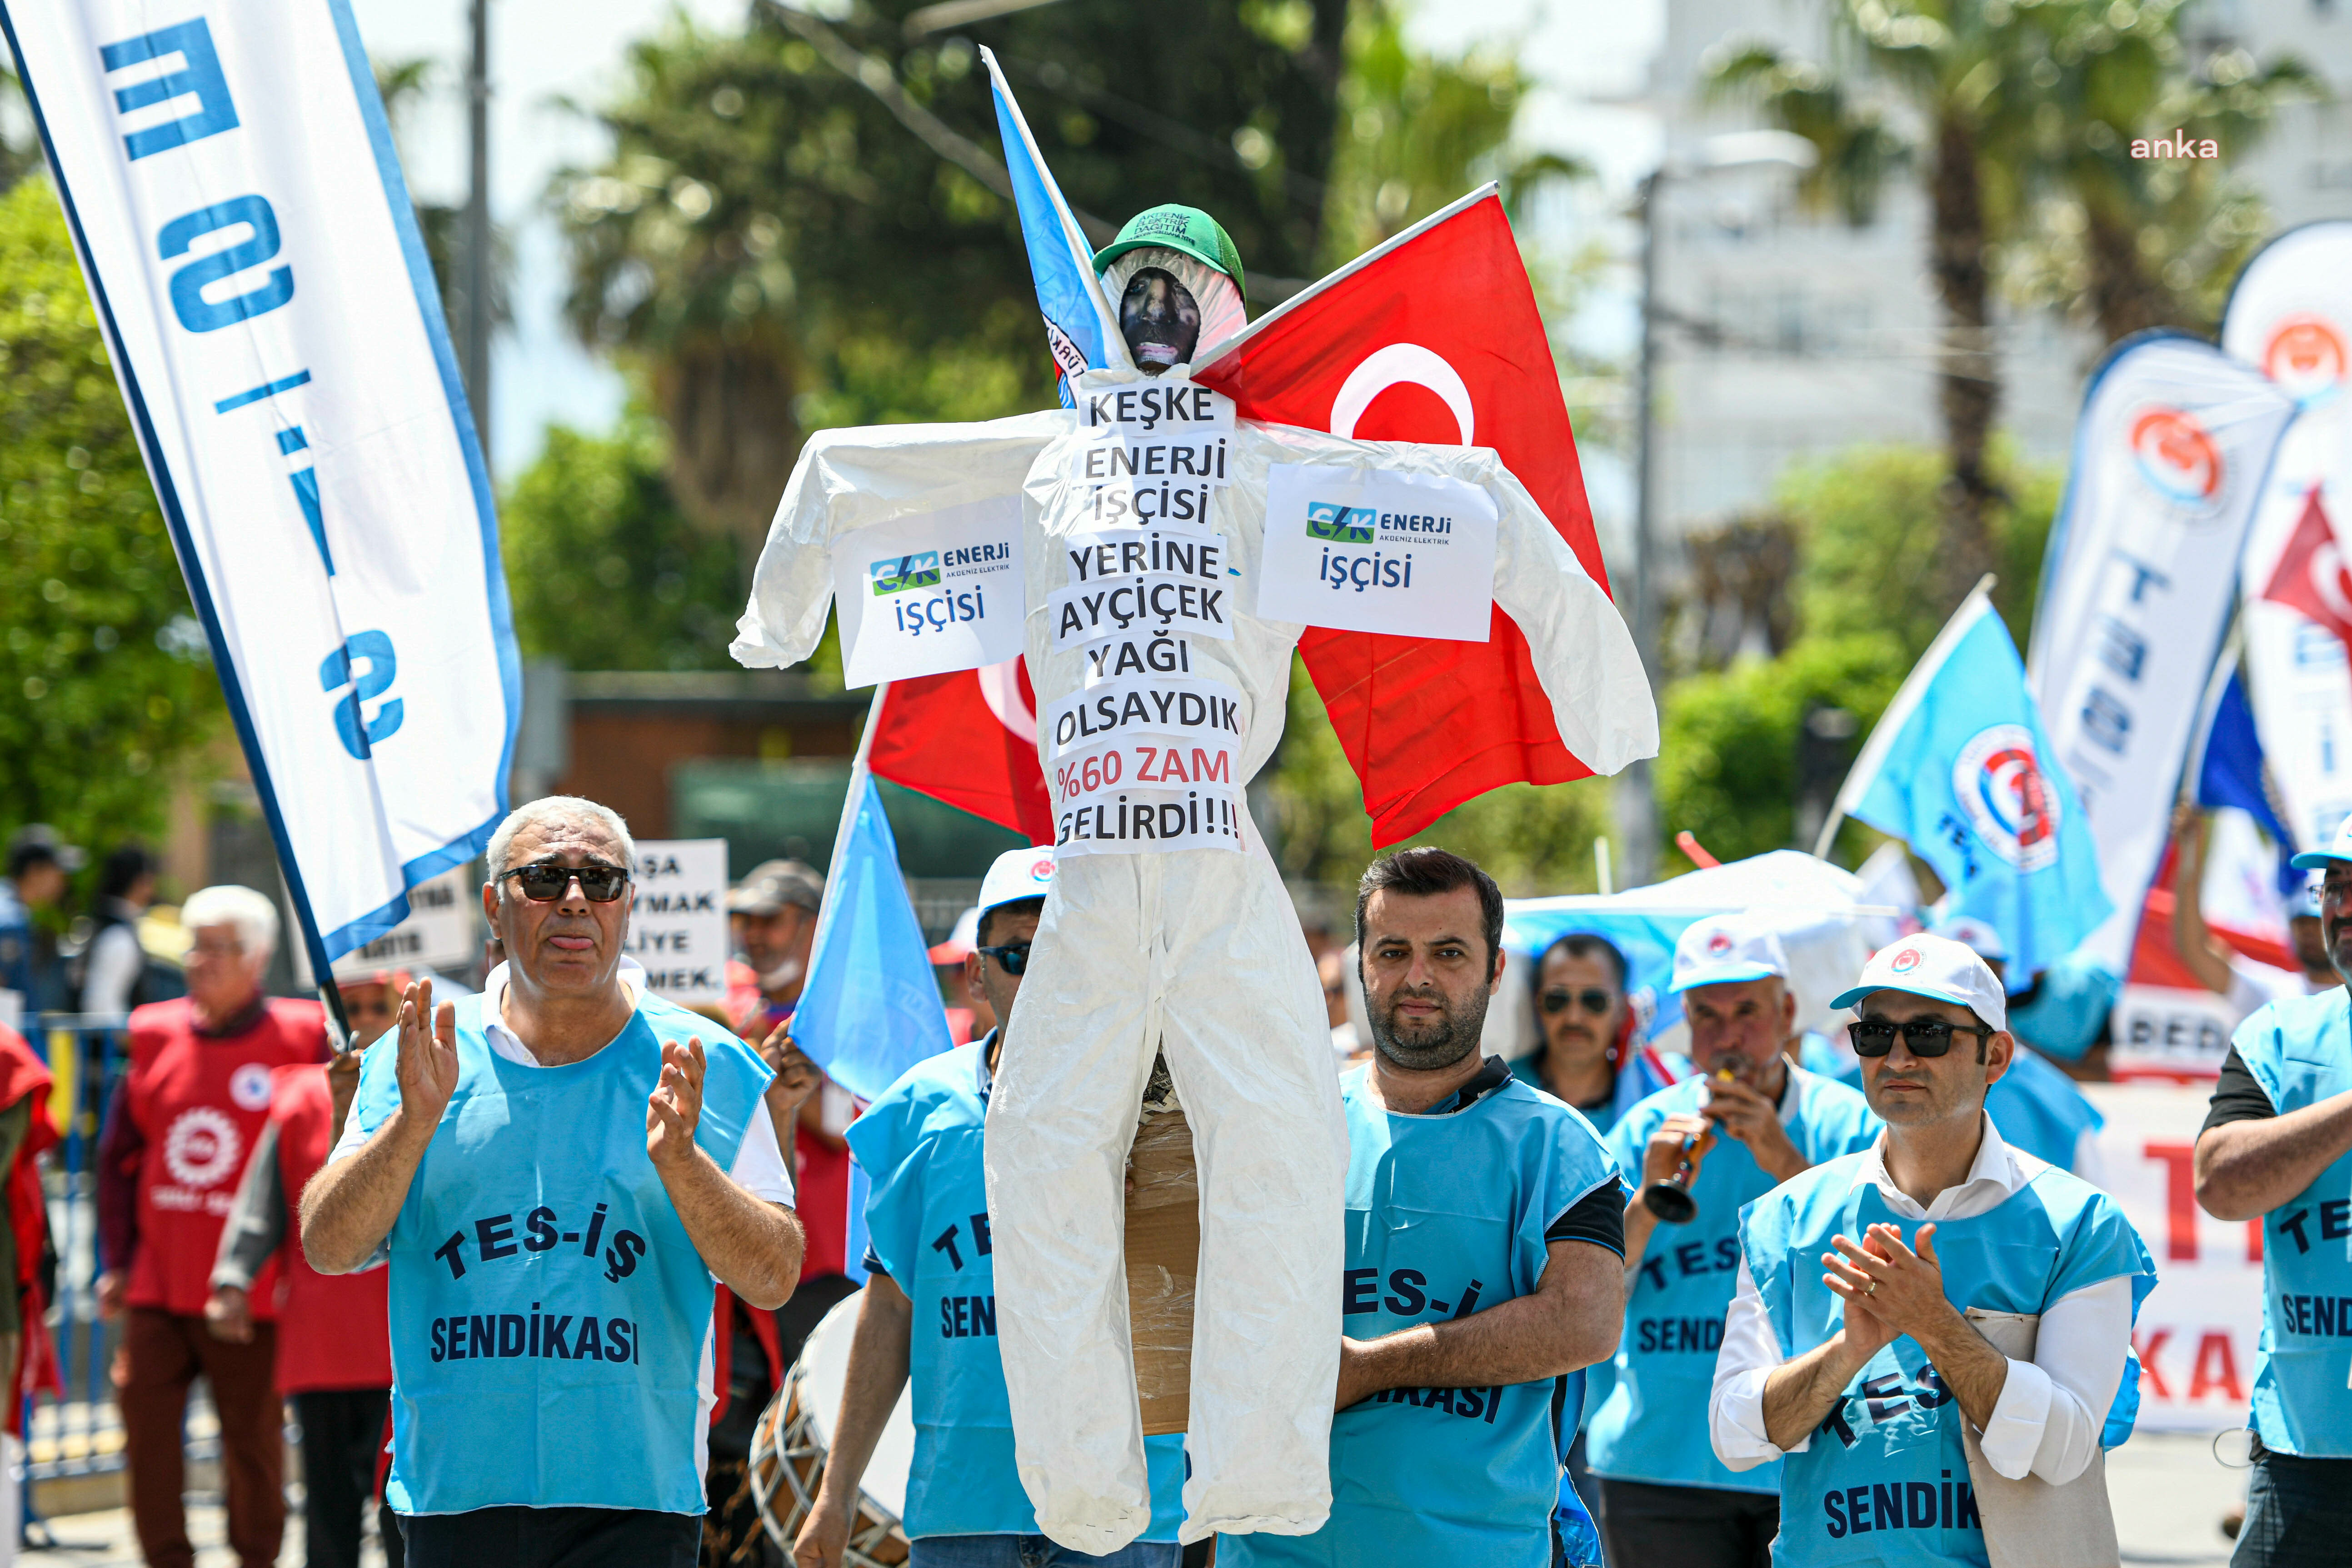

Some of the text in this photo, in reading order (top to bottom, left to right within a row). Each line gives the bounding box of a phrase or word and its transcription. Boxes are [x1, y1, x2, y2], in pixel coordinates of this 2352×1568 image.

[1090, 387, 1214, 430] KEŞKE
[1085, 438, 1226, 479] ENERJİ
[1095, 480, 1208, 524] İŞÇİSİ
[1069, 533, 1219, 581] YERİNE
[1379, 534, 1449, 545] AKDENİZ ELEKTRİK
[946, 564, 1009, 578] AKDENİZ ELEKTRİK
[1320, 547, 1412, 592] İŞÇİSİ
[894, 585, 984, 637] İŞÇİSİ
[1060, 578, 1223, 639] AYÇİÇEK
[1089, 629, 1188, 677] YAĞI
[1057, 690, 1238, 746] OLSAYDIK
[1058, 747, 1229, 803] %60 ZAM
[1057, 791, 1238, 847] GELİRDİ!!!
[633, 854, 682, 879] ŞA
[434, 1203, 646, 1283] TES-İŞ
[430, 1302, 639, 1365] SENDİKASI
